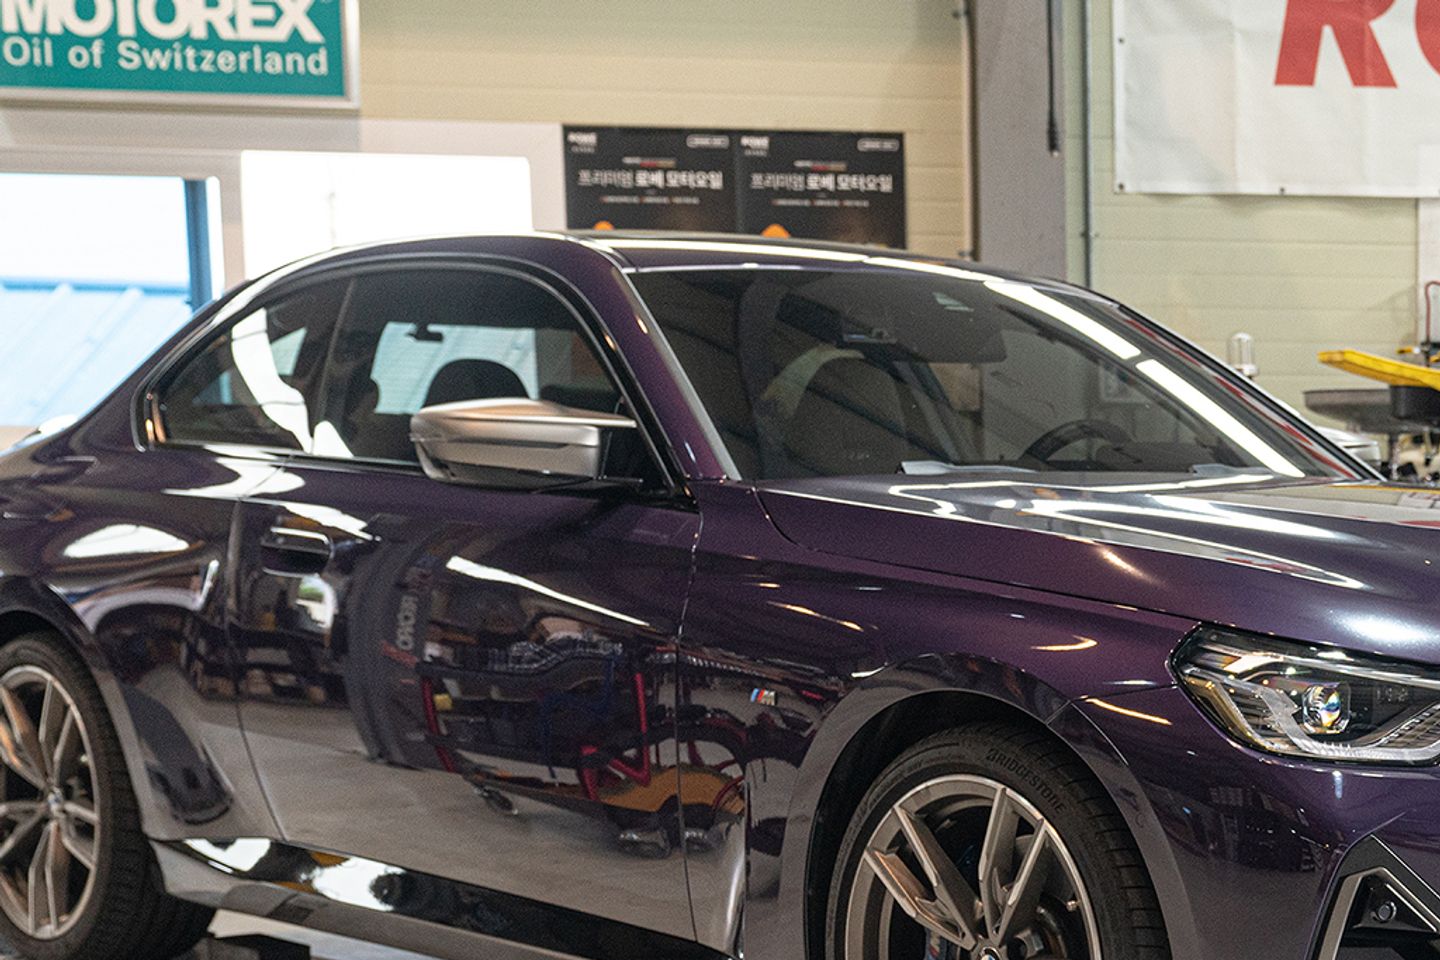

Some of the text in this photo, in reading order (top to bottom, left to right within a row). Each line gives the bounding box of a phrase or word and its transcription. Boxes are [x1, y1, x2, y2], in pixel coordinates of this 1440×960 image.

[1, 0, 326, 43] MOTOREX
[2, 36, 330, 77] Oil of Switzerland
